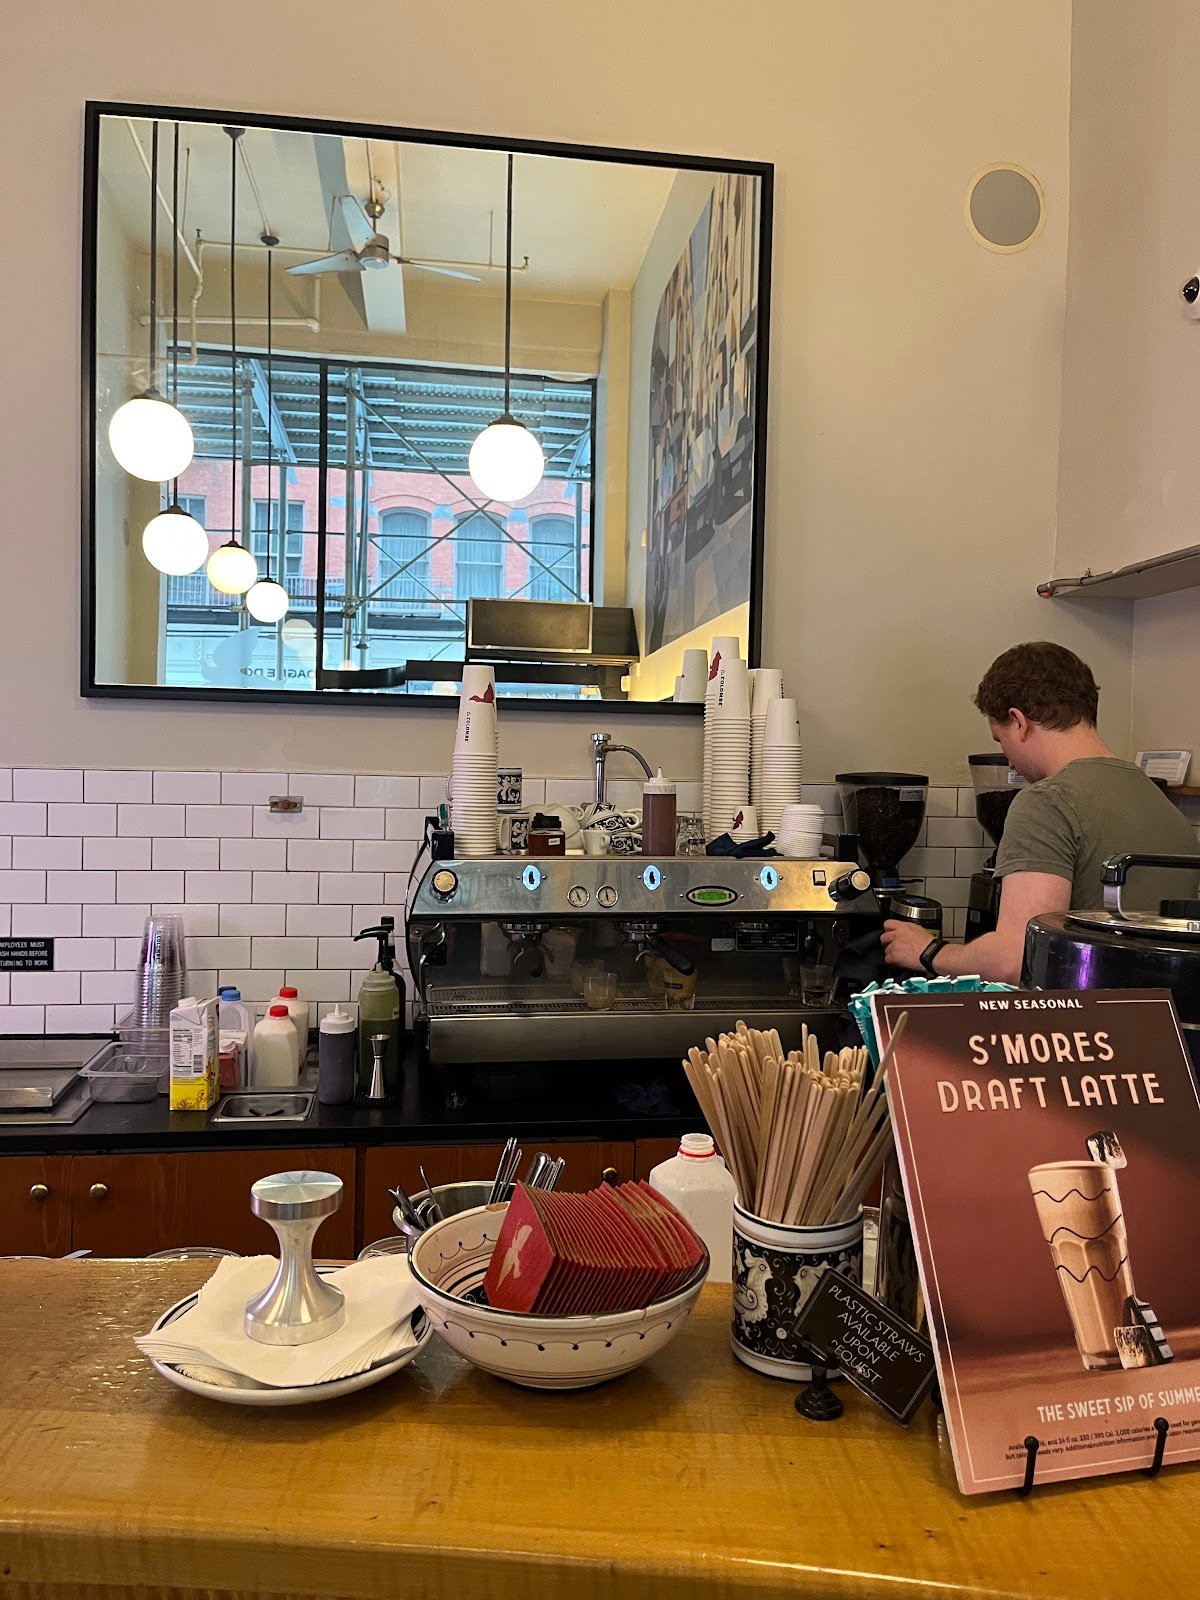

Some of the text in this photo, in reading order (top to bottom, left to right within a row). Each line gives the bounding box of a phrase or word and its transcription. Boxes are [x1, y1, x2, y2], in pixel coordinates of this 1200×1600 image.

[25, 959, 33, 967] TO
[34, 959, 49, 967] WORK
[979, 998, 1083, 1011] NEW SEASONAL
[968, 1031, 1115, 1066] S'MORES
[936, 1073, 1165, 1113] DRAFT LATTE
[828, 1284, 926, 1364] PLASTIC STRAWS
[837, 1312, 901, 1362] AVAILABLE
[842, 1331, 881, 1365] UPON
[1037, 1403, 1065, 1423] THE
[1067, 1397, 1112, 1419] SWEET
[1116, 1394, 1135, 1413] SIP
[1138, 1392, 1155, 1409] OF
